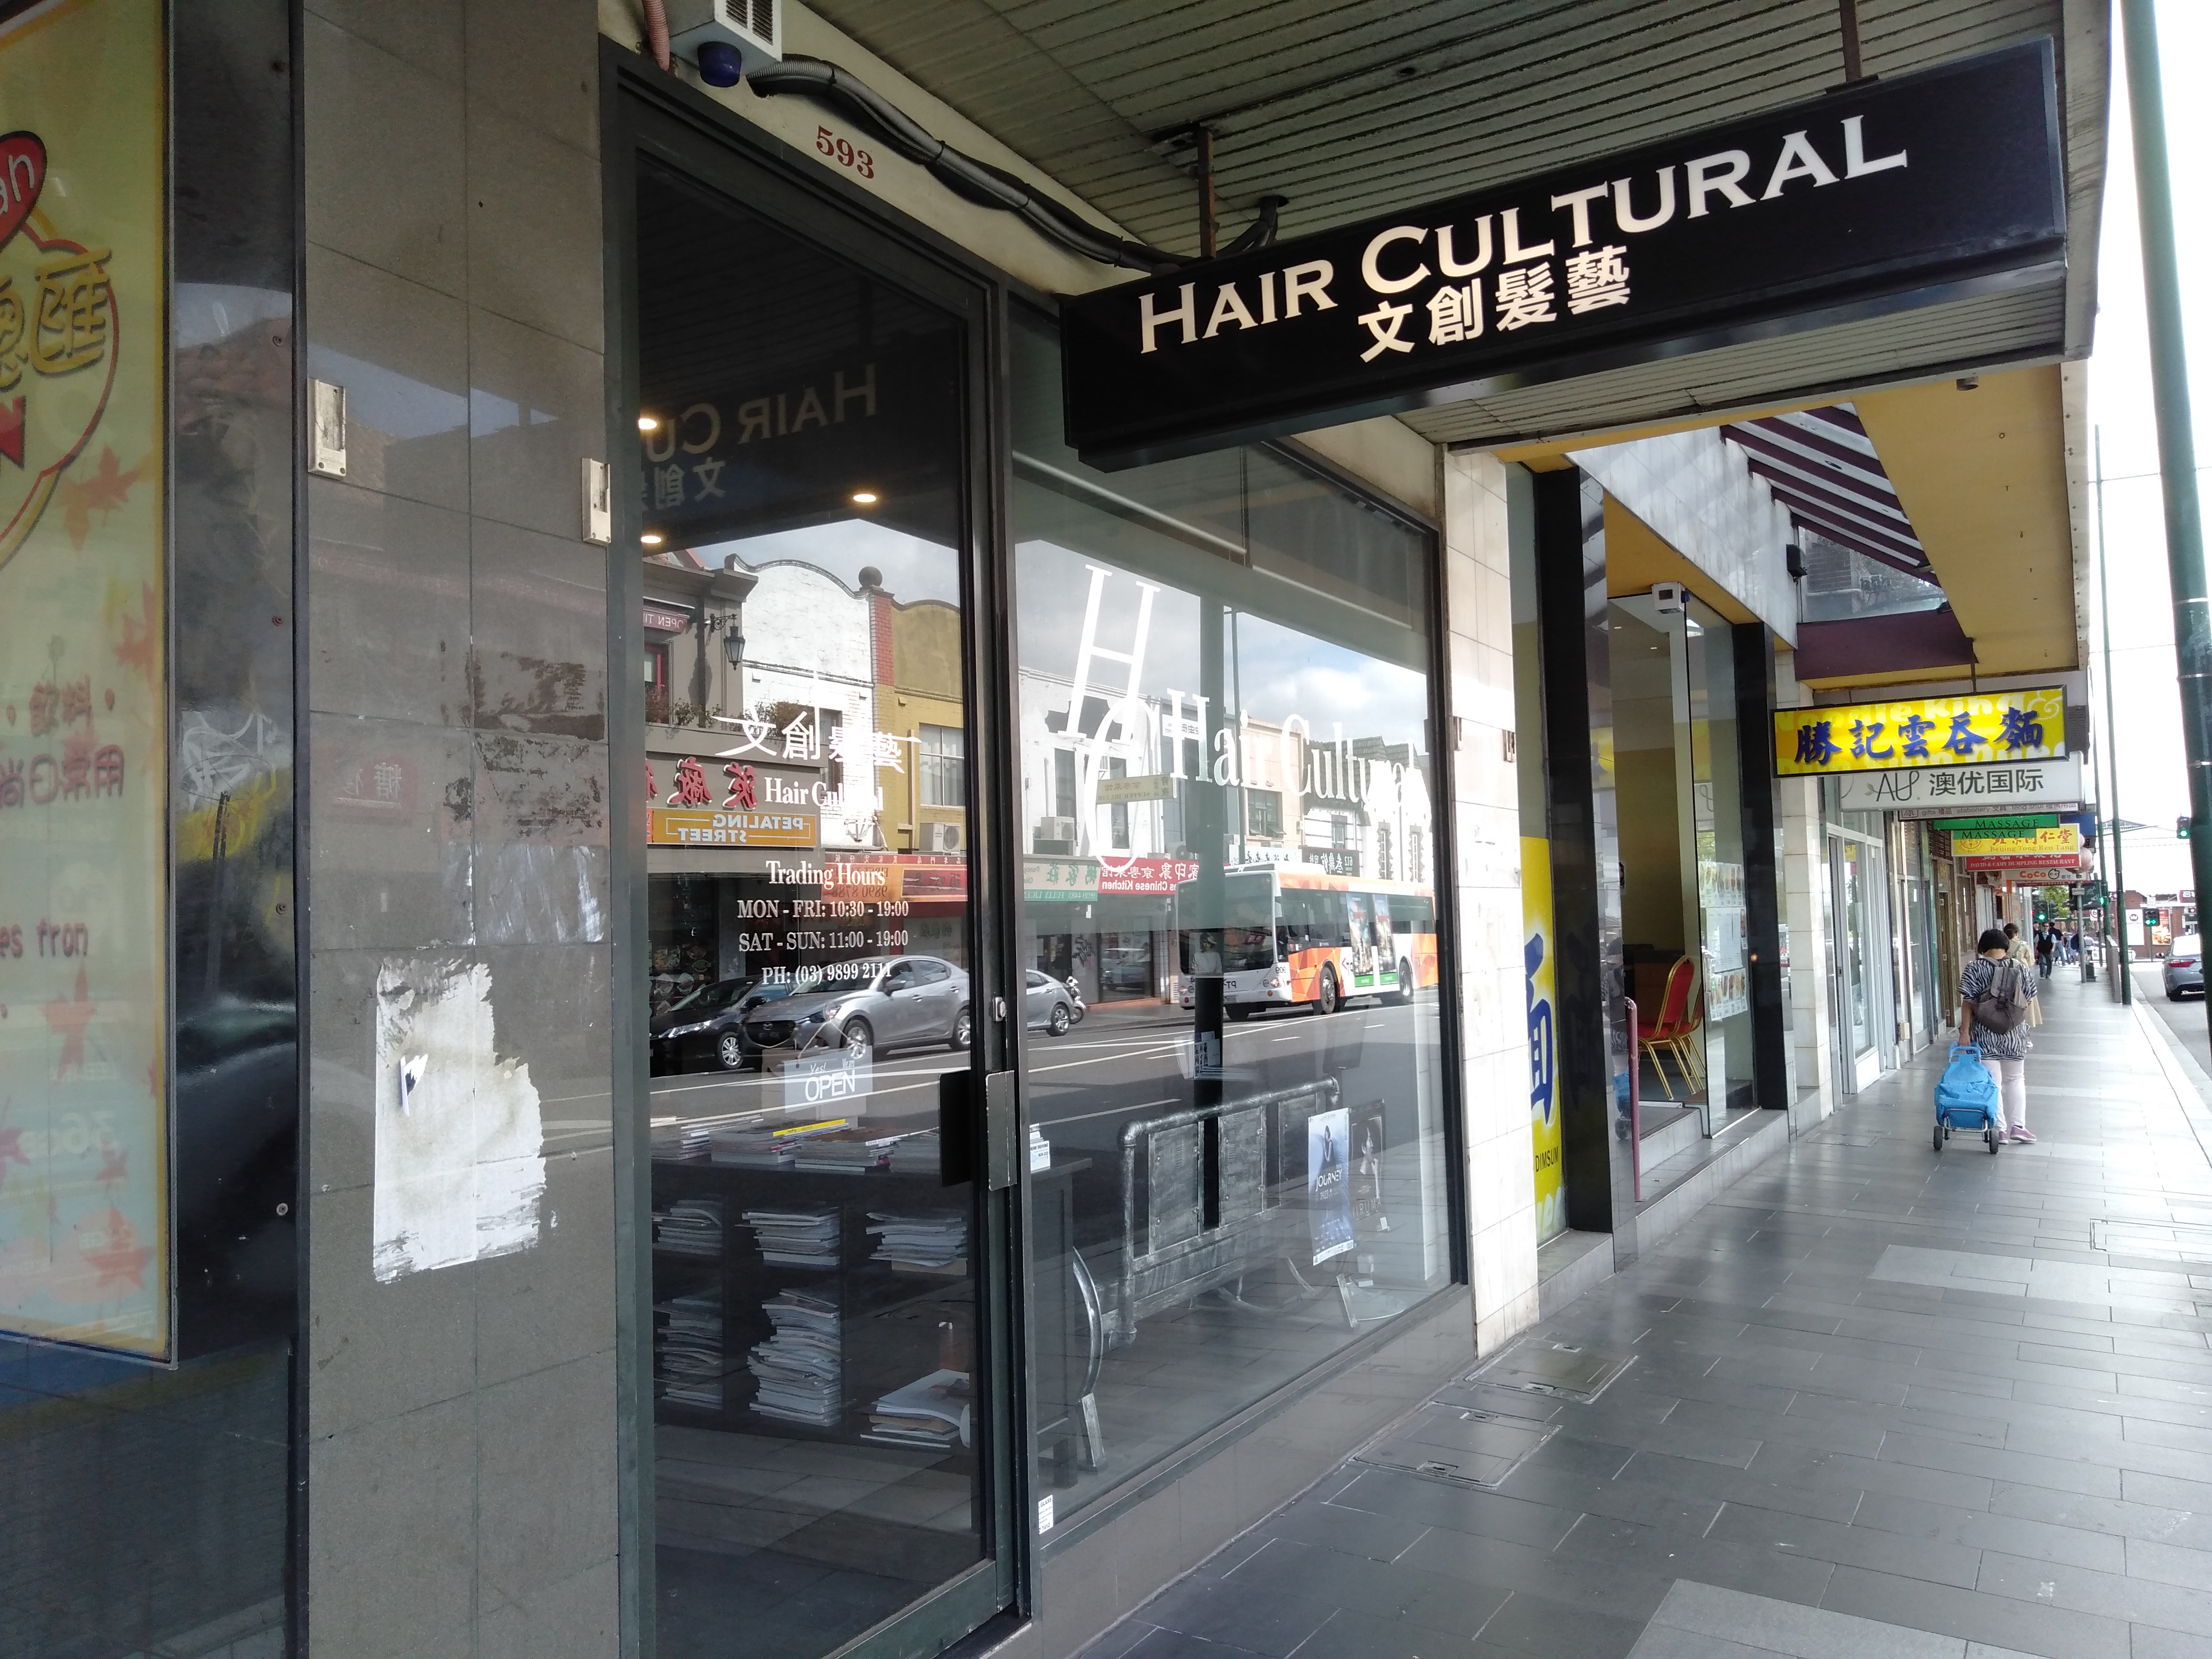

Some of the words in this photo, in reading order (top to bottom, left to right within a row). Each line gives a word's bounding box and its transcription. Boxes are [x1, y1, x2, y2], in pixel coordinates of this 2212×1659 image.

[816, 125, 874, 179] 593
[0, 153, 35, 214] n
[1138, 258, 1337, 355] HAIR
[1360, 115, 1908, 294] CULTURAL
[1358, 245, 1630, 364] 文創髮藝
[1167, 688, 1273, 787] Hair
[1794, 707, 2043, 766] 勝記雲吞麵
[765, 777, 809, 805] Hair
[812, 781, 884, 811] Culal
[1929, 768, 2045, 797] 澳优国际
[1961, 830, 2025, 840] MASSAGE
[1975, 819, 2039, 828] MASSAGE
[766, 860, 834, 889] Trading
[836, 862, 887, 887] Hours
[737, 900, 780, 919] MON
[792, 900, 826, 918] FRI:
[830, 900, 865, 917] 10:30
[876, 900, 909, 917] 19:00
[739, 933, 774, 952] SAT
[786, 932, 825, 950] SUN:
[829, 931, 864, 949] 11:00
[876, 930, 908, 946] 19:00
[761, 966, 791, 985] PH:
[795, 965, 823, 985] (03)
[826, 963, 859, 982] 9899
[862, 962, 892, 979] 2111
[809, 1062, 826, 1076] Yes!
[842, 1058, 849, 1069] We
[805, 1069, 856, 1102] OPEN
[1535, 1146, 1559, 1172] DIMSUM
[1315, 1169, 1343, 1192] JOURNEY
[1040, 1497, 1052, 1508] GLASS
